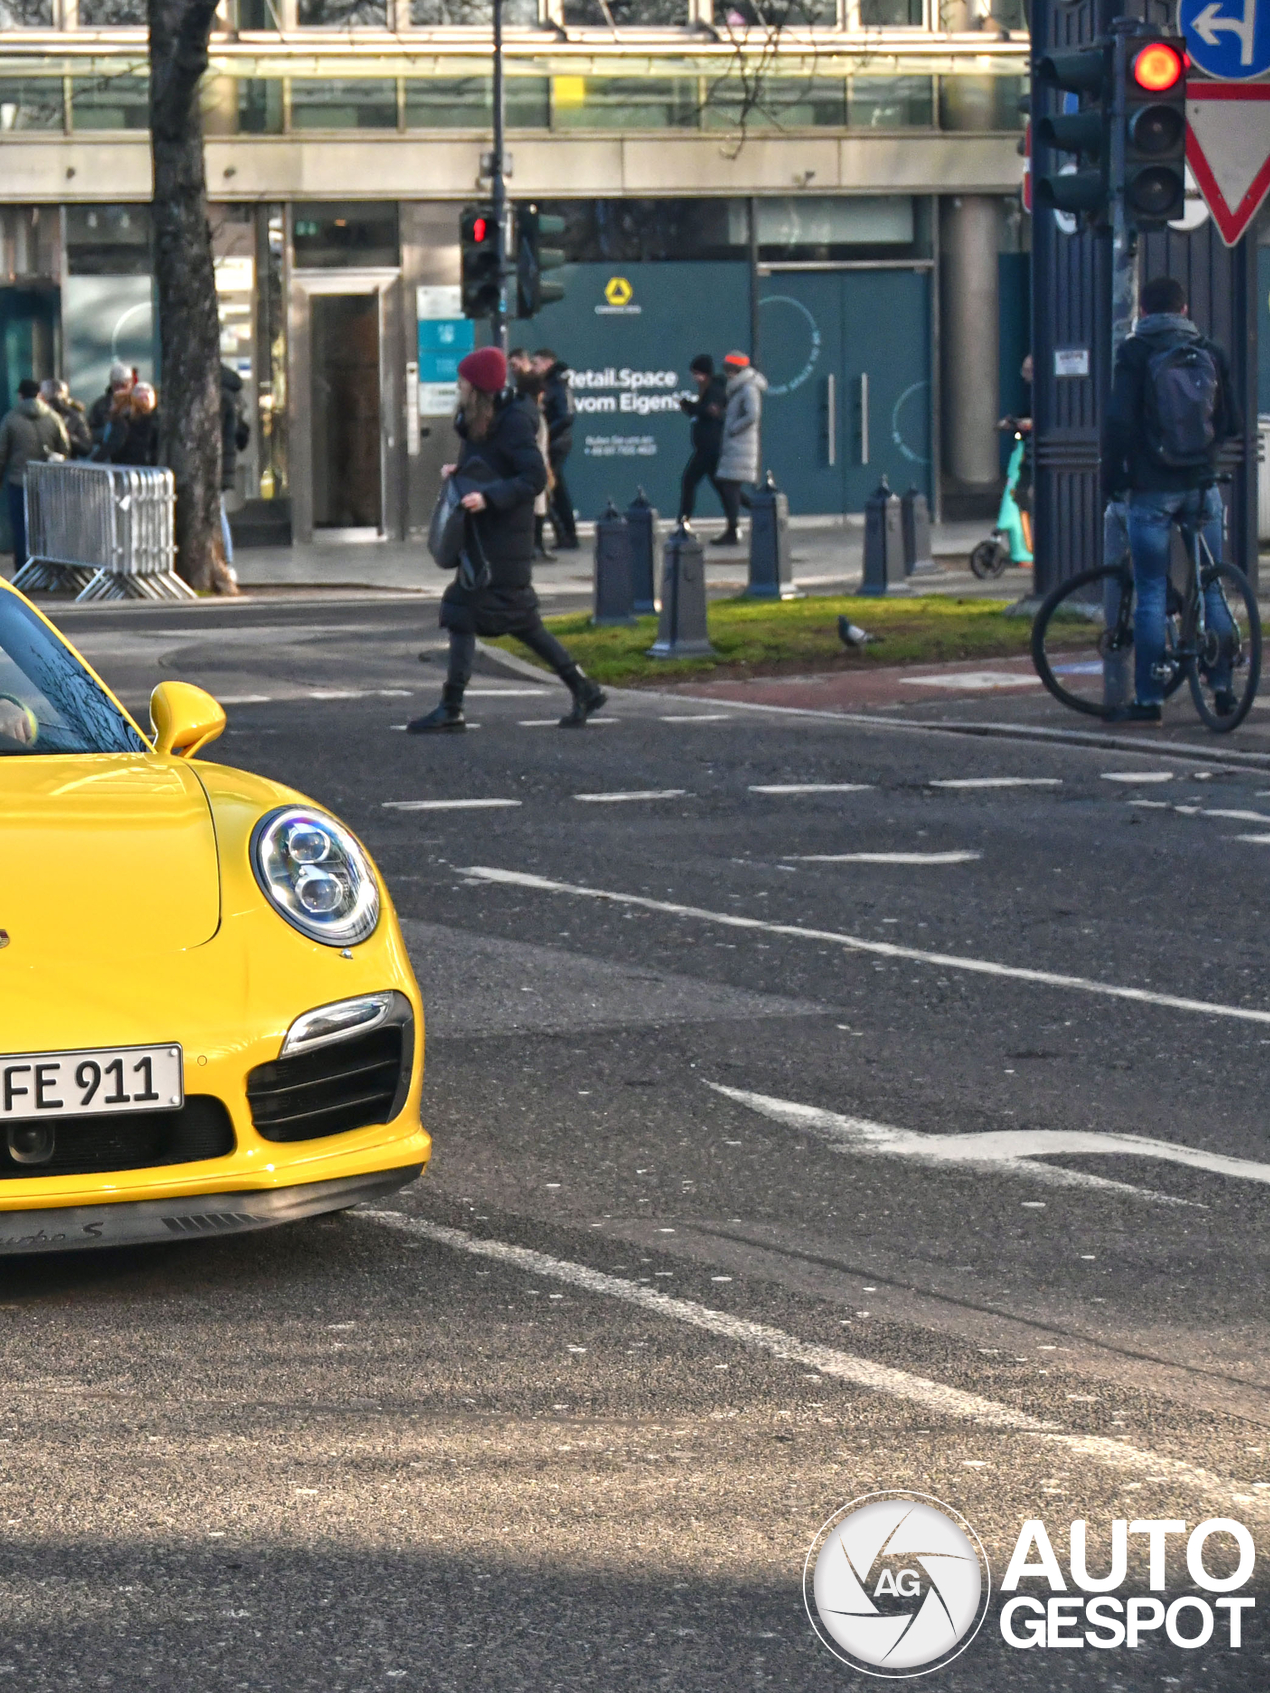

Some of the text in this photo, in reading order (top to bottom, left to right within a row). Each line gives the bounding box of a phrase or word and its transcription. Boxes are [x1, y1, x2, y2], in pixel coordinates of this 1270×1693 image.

[574, 396, 616, 413] vom
[4, 1063, 64, 1111] FE
[76, 1056, 159, 1106] 911
[81, 1222, 104, 1240] S
